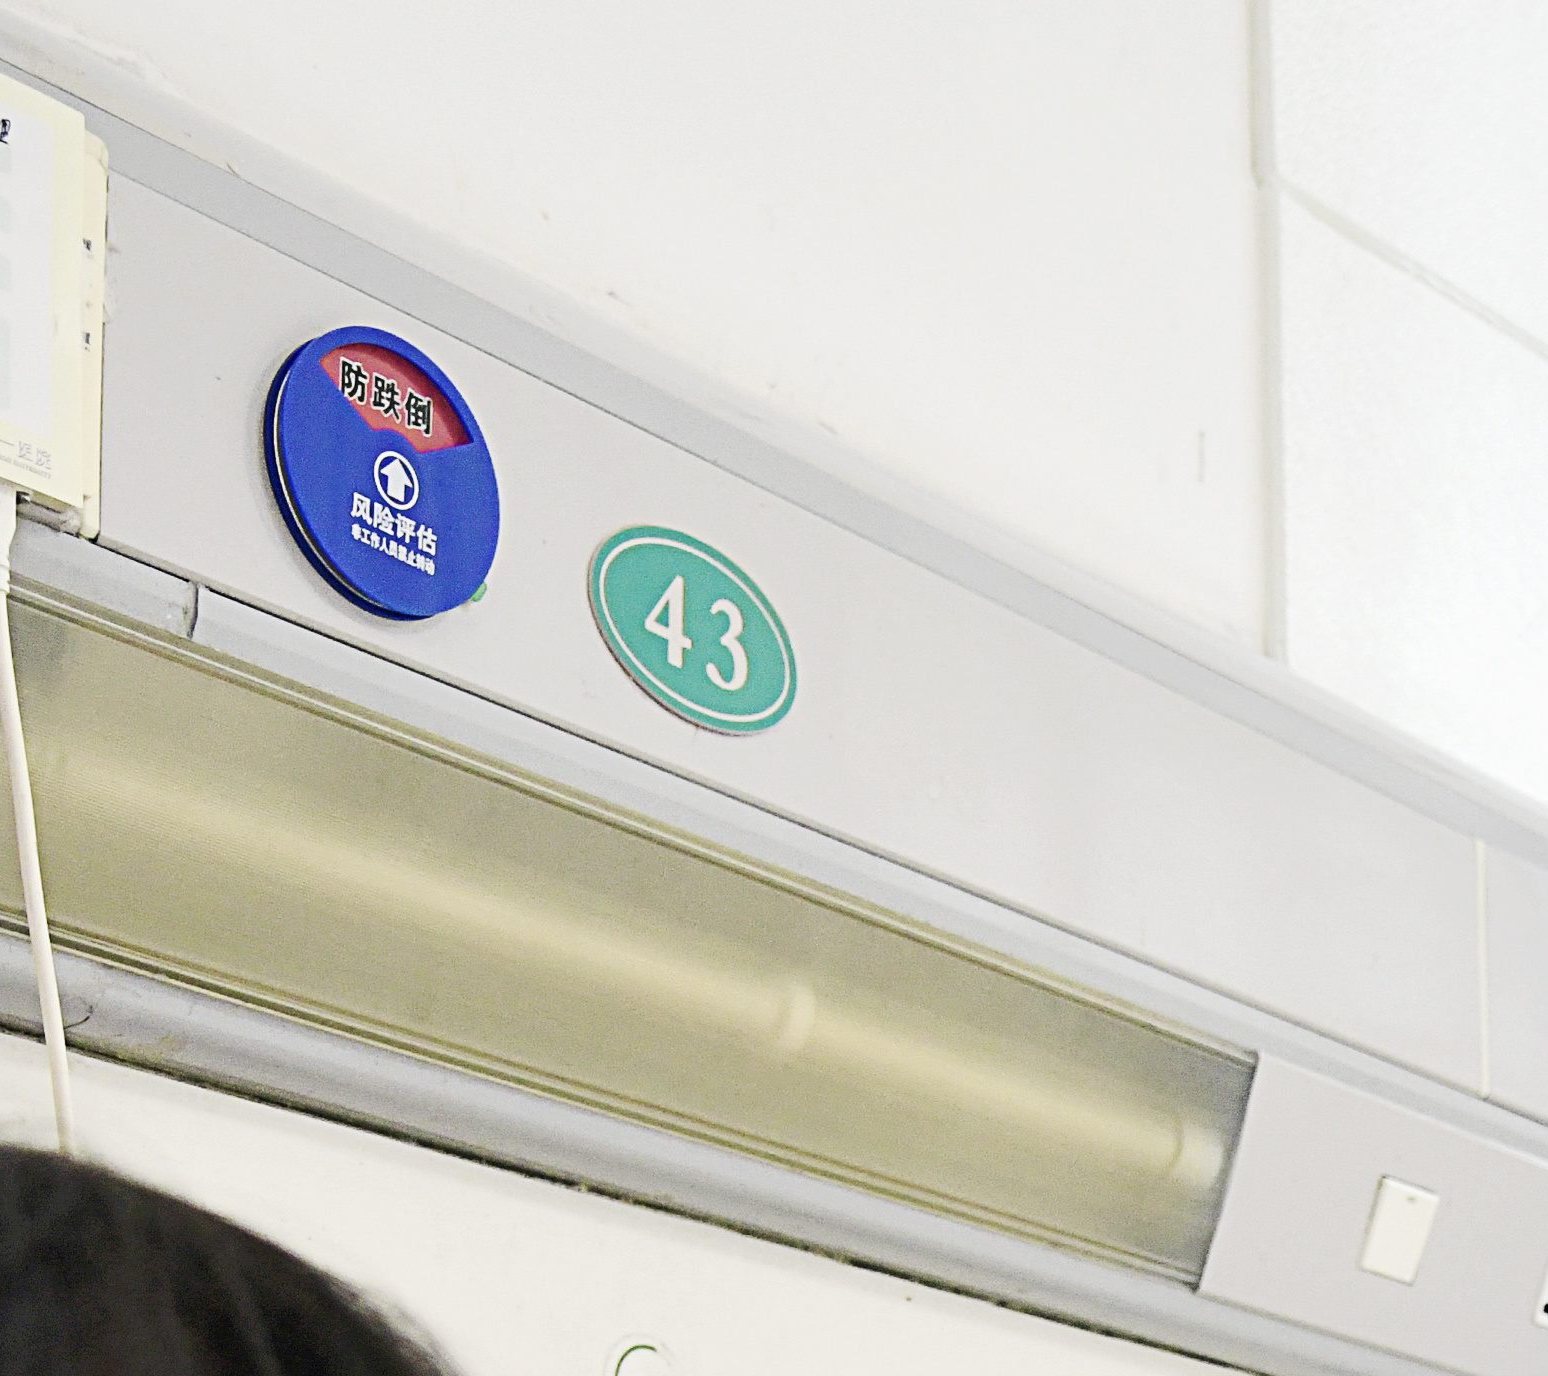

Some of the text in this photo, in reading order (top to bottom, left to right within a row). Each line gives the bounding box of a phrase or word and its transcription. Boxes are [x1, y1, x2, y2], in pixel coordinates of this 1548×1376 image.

[339, 357, 433, 437] 防跌倒
[350, 491, 438, 557] 风险评估
[643, 574, 750, 692] 43
